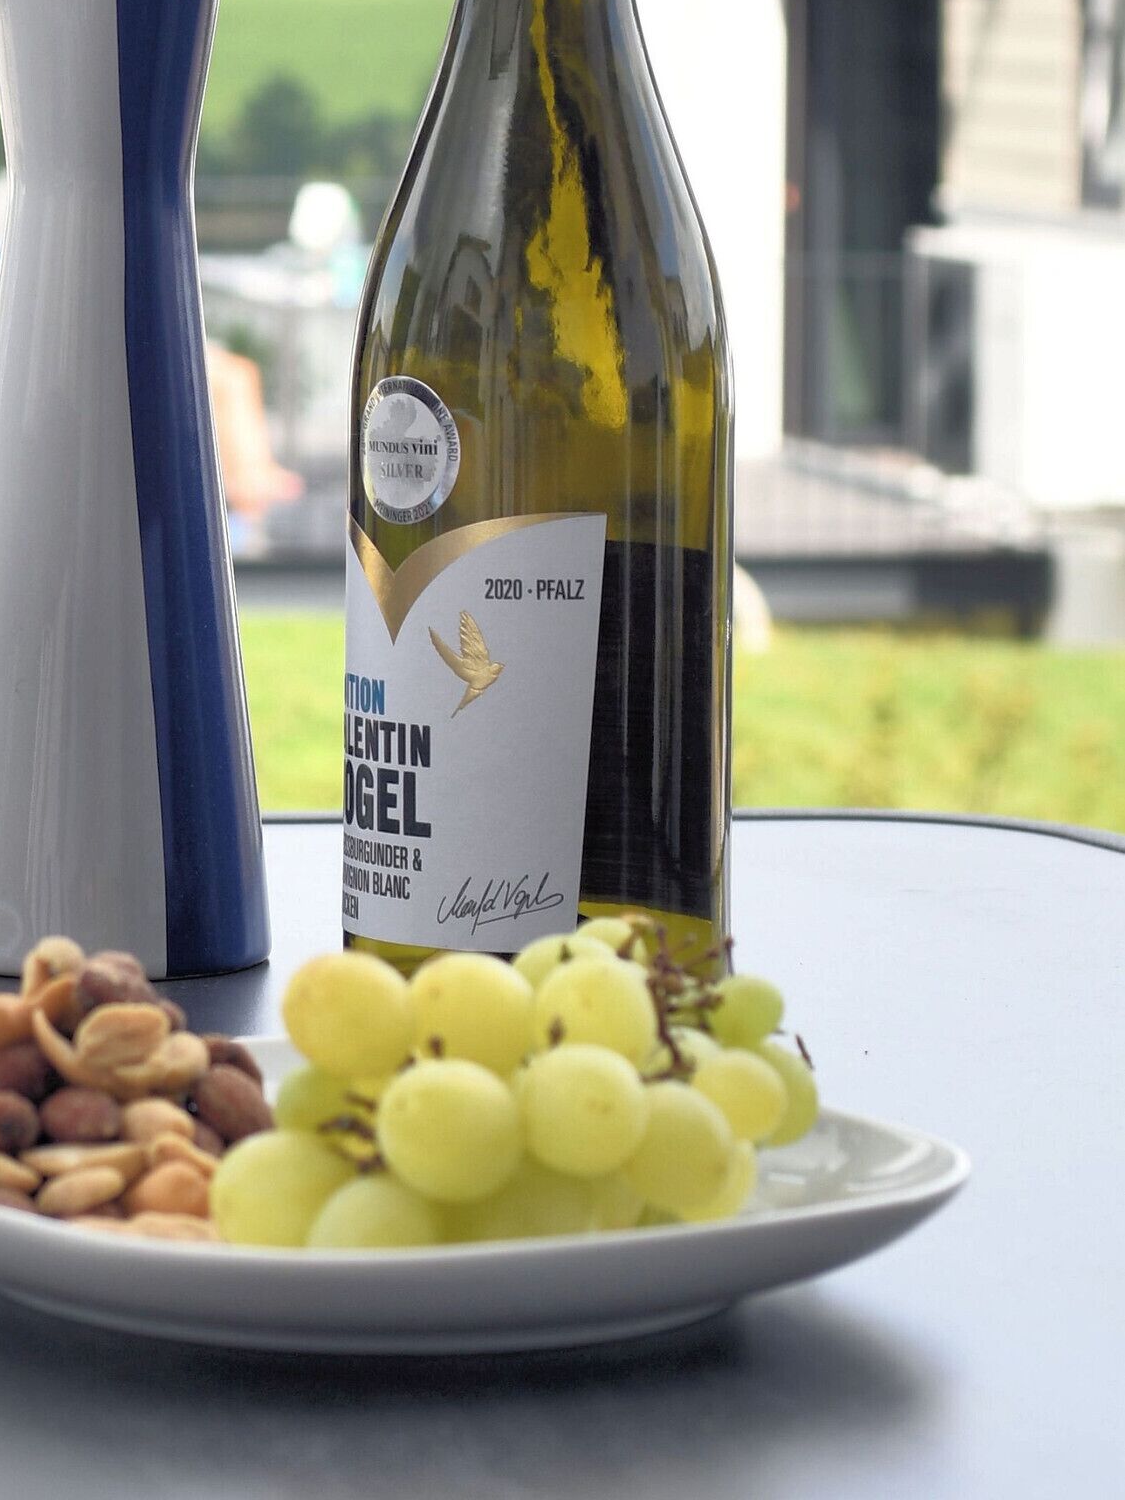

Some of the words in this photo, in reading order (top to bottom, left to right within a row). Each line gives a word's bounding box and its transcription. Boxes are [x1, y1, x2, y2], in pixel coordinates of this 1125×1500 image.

[369, 440, 409, 454] MUNDUS
[443, 423, 459, 462] AWARD
[380, 463, 424, 479] SILVER
[484, 578, 523, 600] 2020
[536, 579, 585, 600] PFALZ
[344, 712, 431, 768] LENTIN
[412, 848, 422, 872] &
[372, 871, 411, 900] BLANC
